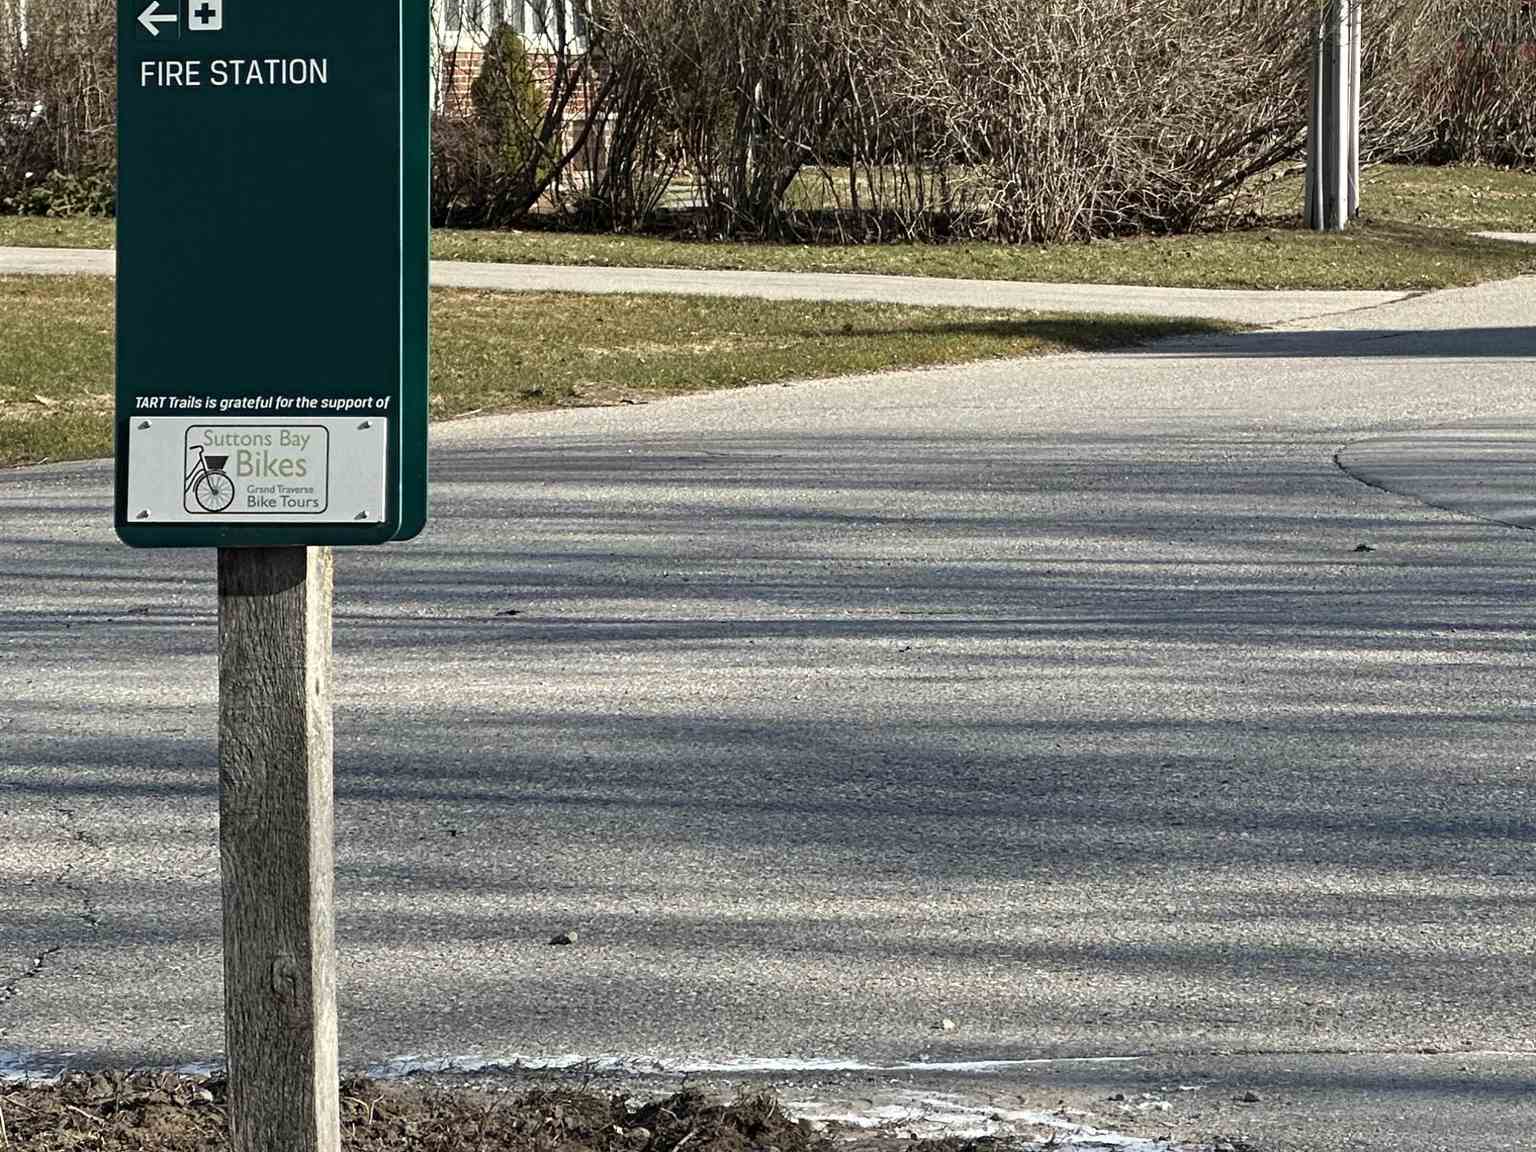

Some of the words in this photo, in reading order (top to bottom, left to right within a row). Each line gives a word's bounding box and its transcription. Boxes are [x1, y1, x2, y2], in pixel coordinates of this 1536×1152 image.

[141, 61, 201, 86] FIRE
[210, 59, 328, 85] STATION
[135, 396, 166, 409] TART
[169, 396, 202, 409] Trails
[205, 397, 217, 409] is
[219, 396, 273, 411] grateful
[275, 396, 294, 410] for
[296, 396, 318, 408] the
[320, 397, 373, 411] support
[375, 395, 391, 410] of
[203, 429, 272, 447] Suttons
[279, 429, 311, 452] Bay
[236, 450, 307, 477] Bikes
[247, 485, 275, 494] Grand
[278, 485, 314, 494] Traverse
[247, 495, 277, 508] Bike
[280, 495, 320, 508] Tours
